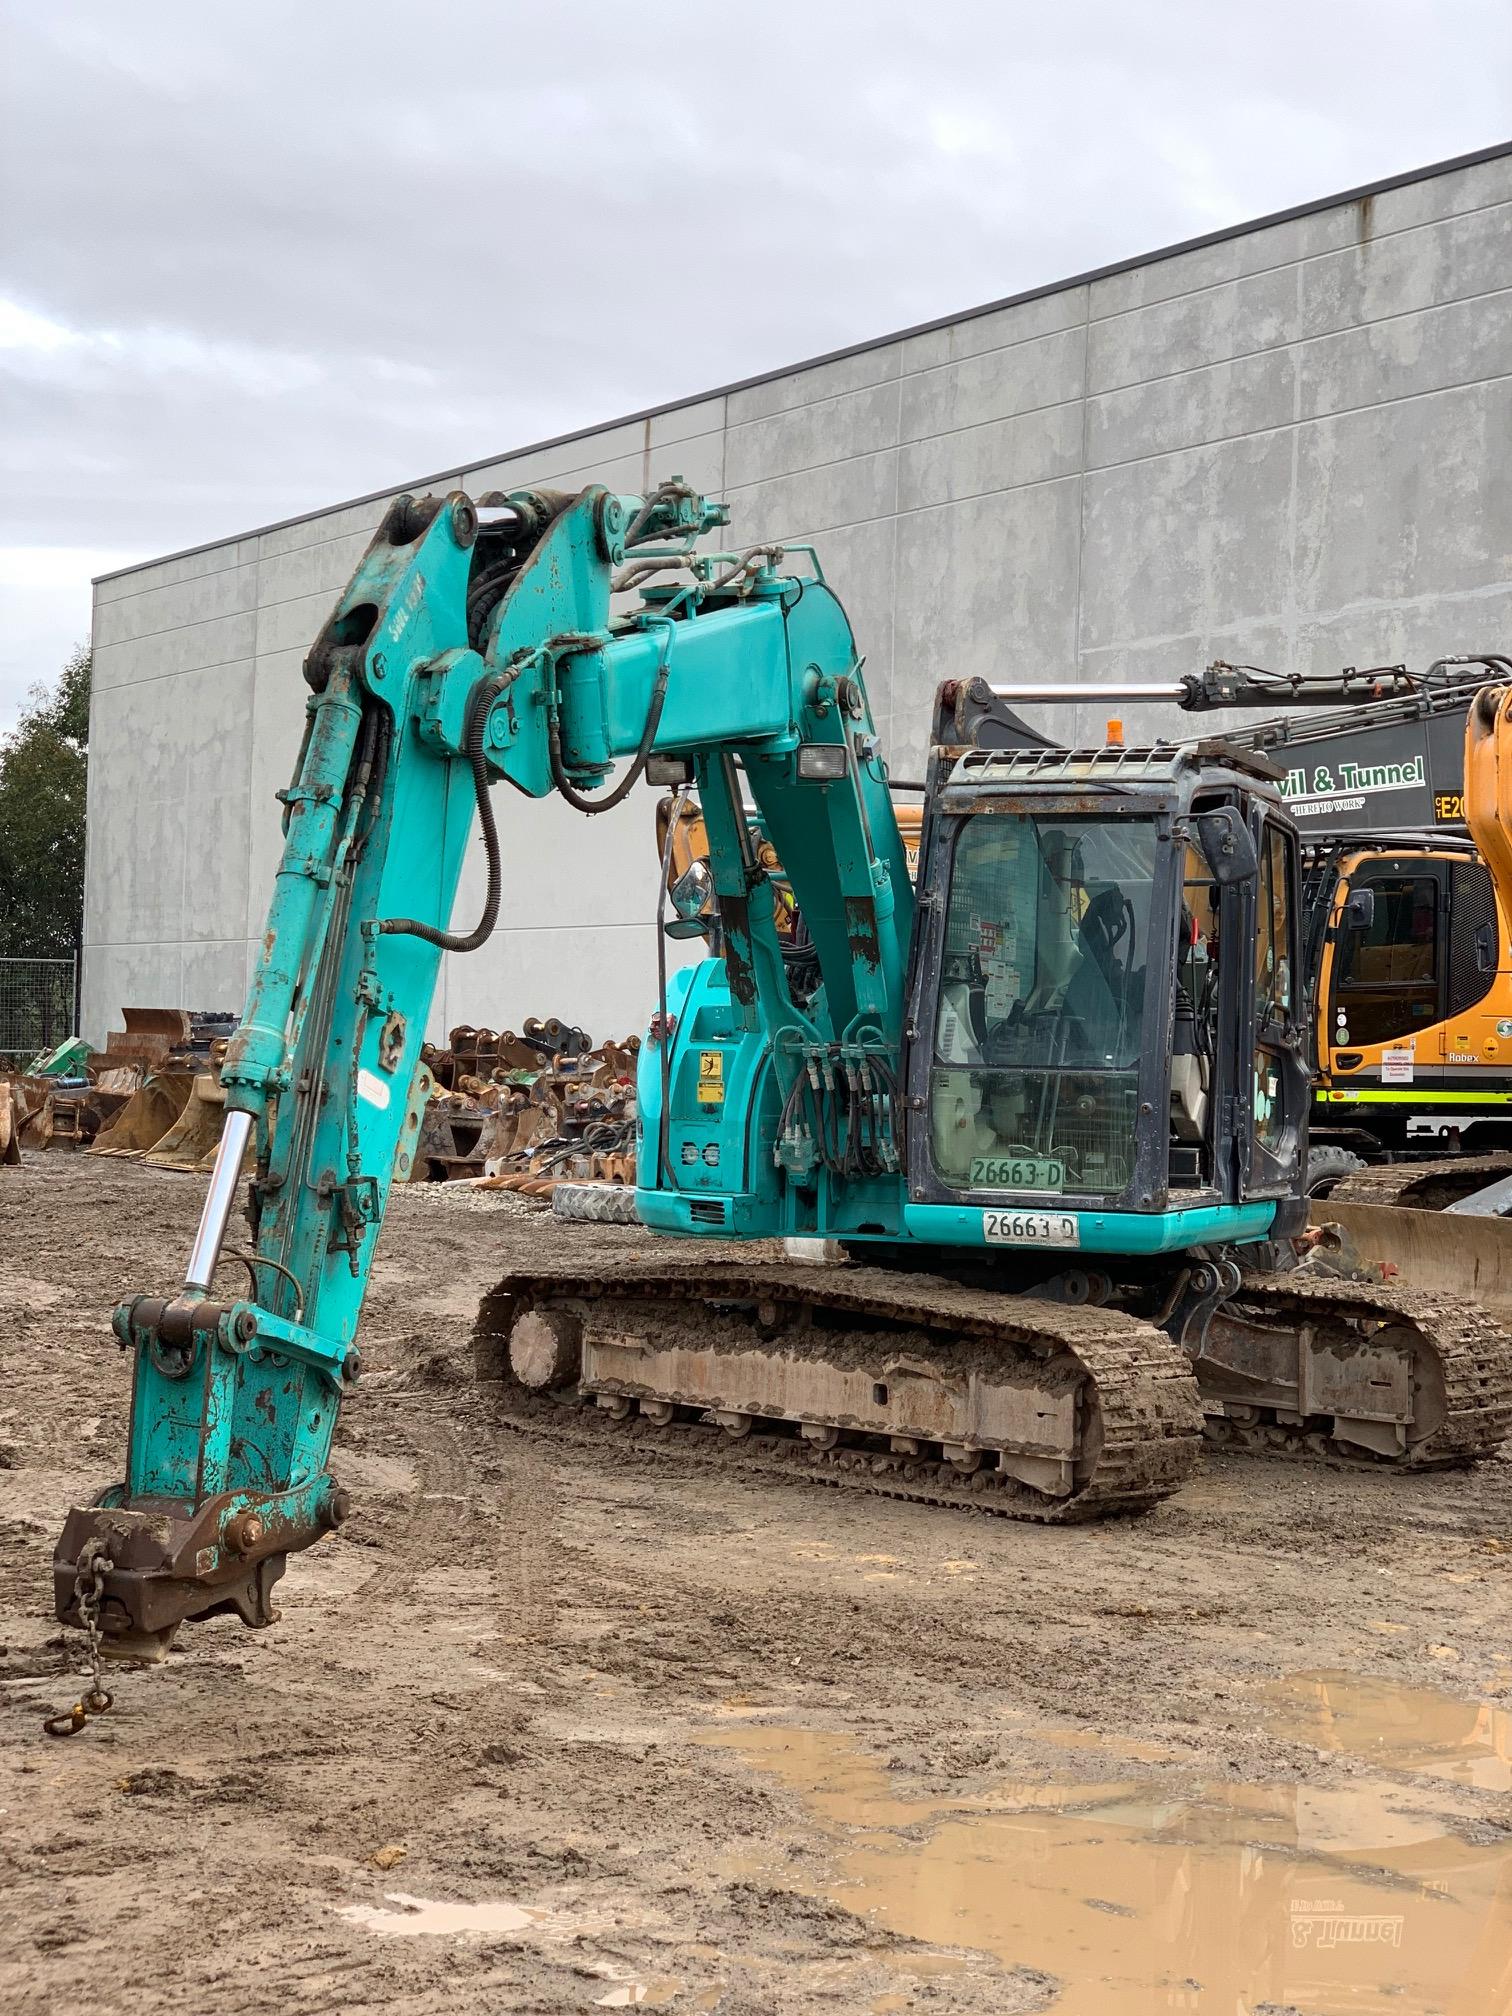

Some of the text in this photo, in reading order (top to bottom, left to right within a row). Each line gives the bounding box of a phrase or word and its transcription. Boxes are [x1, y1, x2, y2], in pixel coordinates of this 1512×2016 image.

[1275, 756, 1425, 797] vil & Tunnel
[1321, 801, 1333, 812] TO
